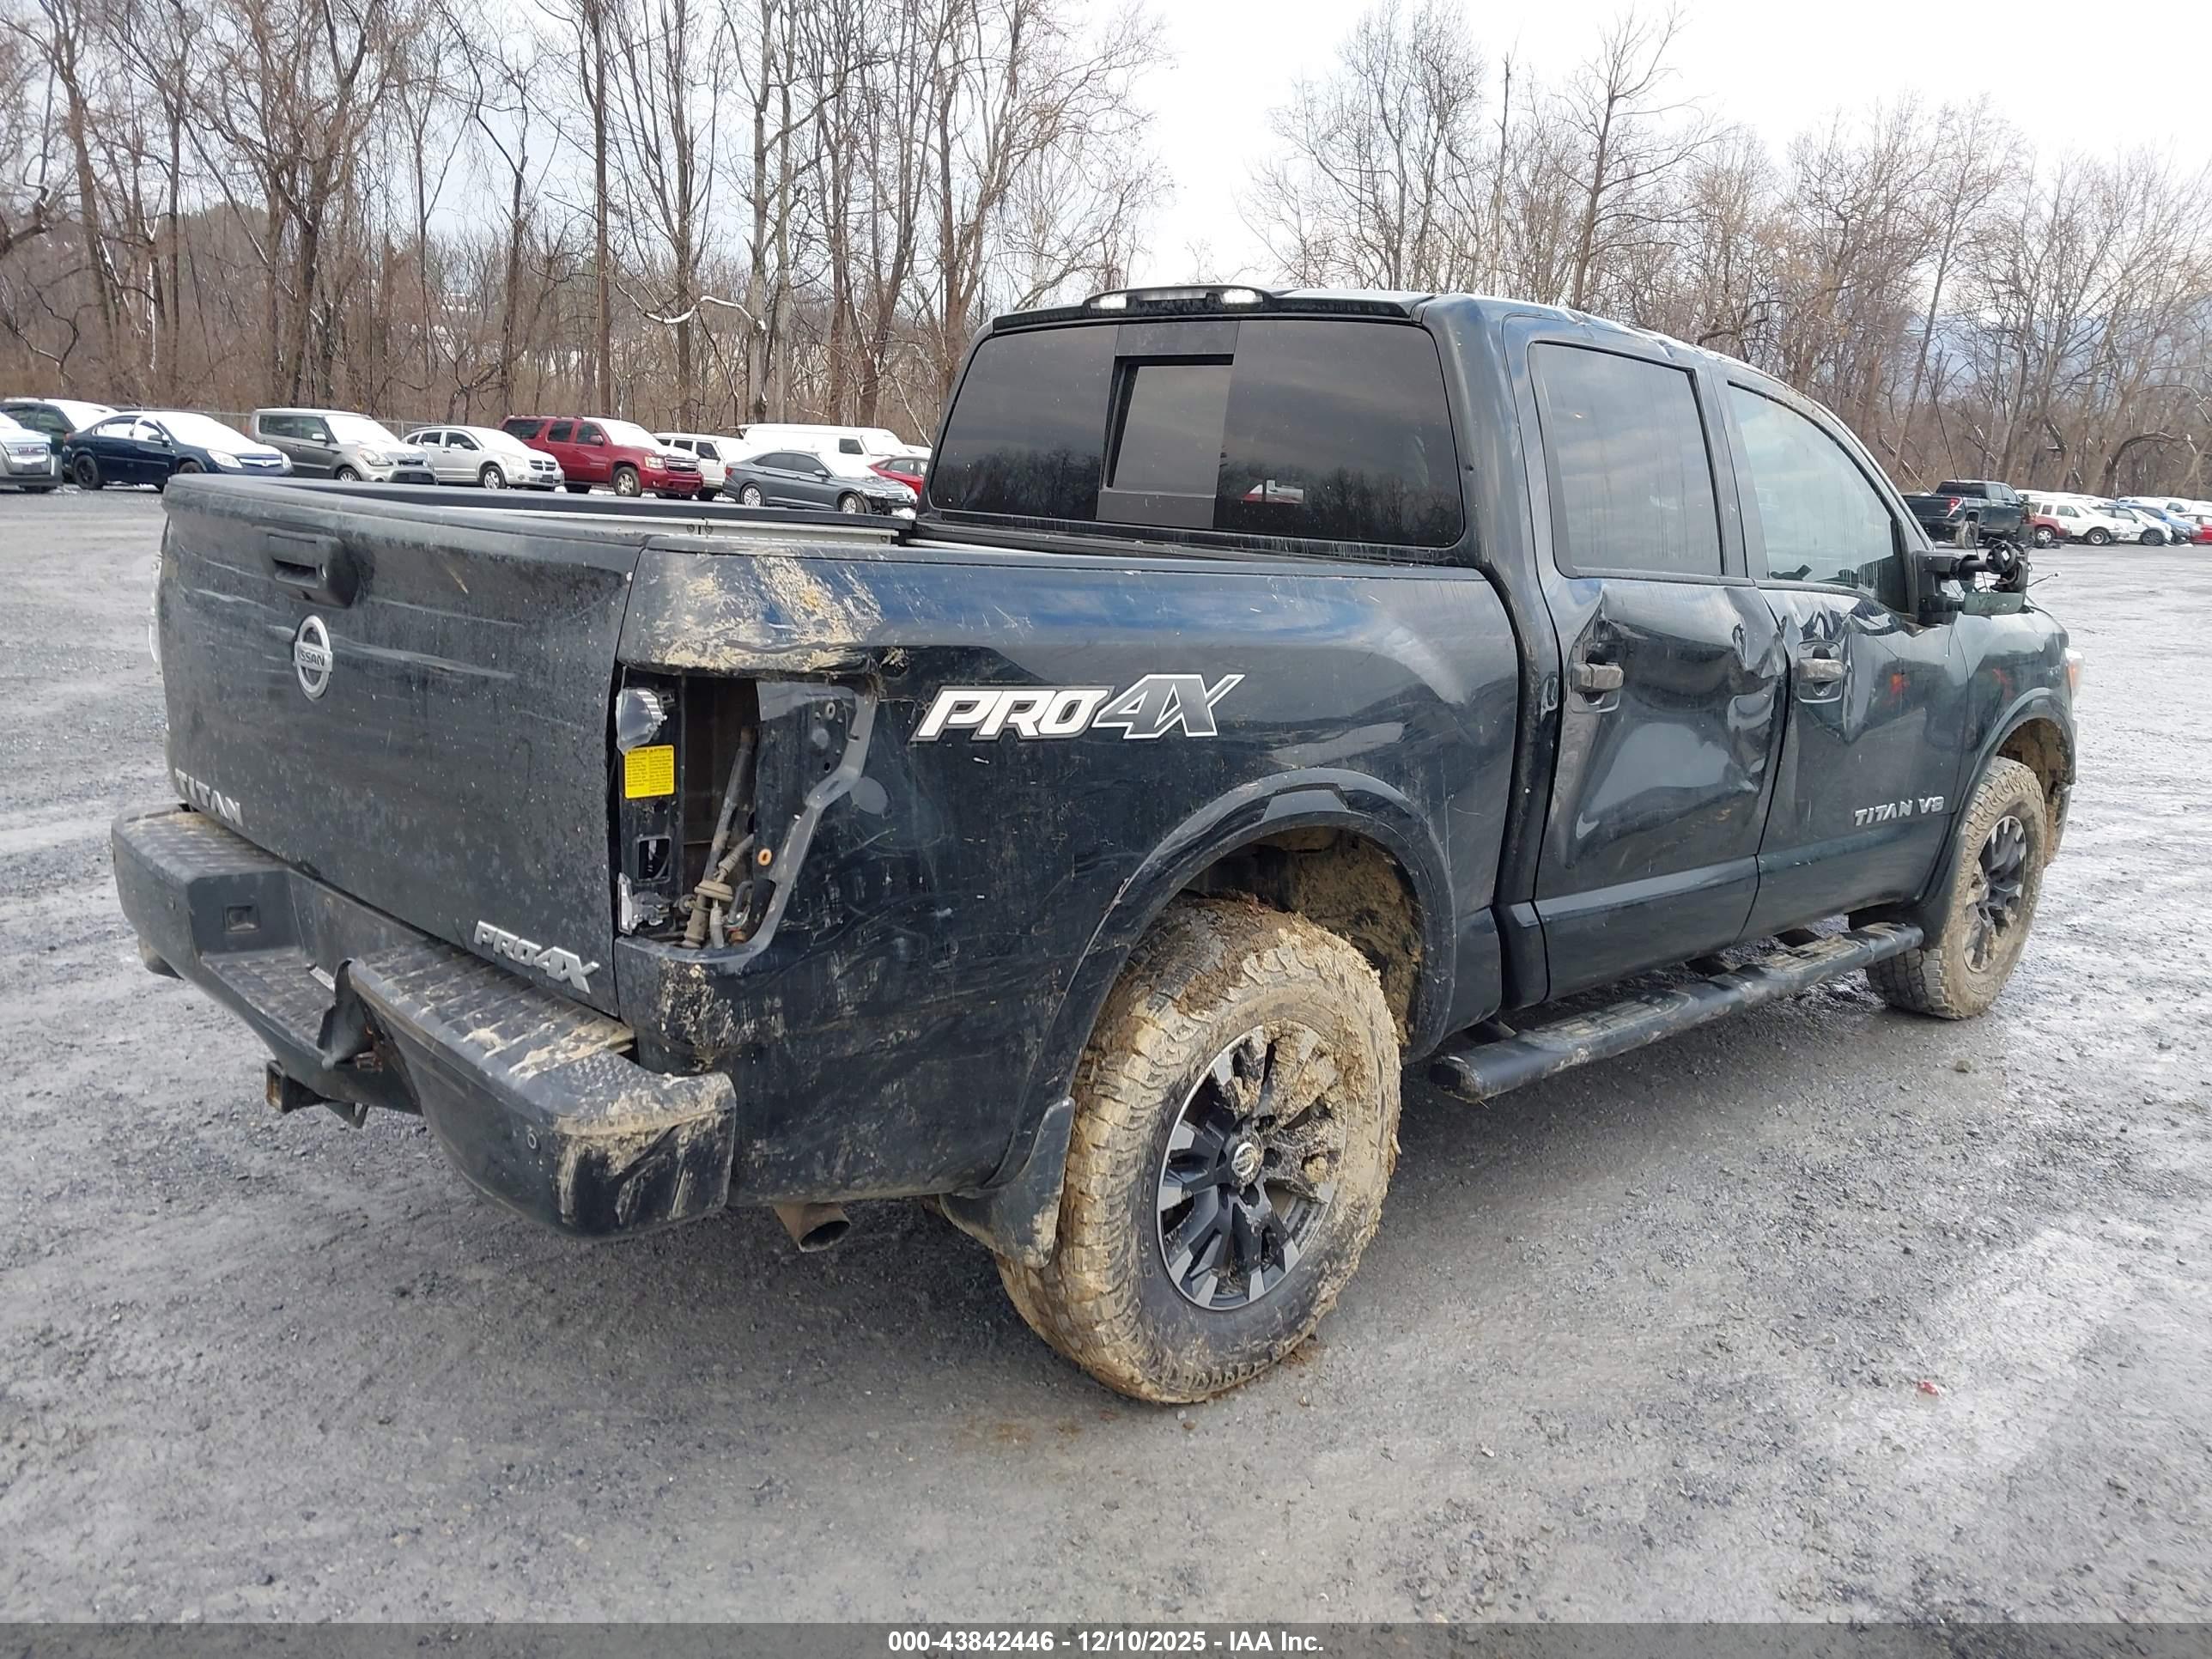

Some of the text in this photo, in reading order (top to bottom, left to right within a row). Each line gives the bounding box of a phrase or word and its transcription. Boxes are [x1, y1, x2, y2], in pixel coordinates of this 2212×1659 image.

[297, 650, 325, 667] SSAN
[174, 767, 243, 827] TITAN
[1855, 796, 1945, 826] TITAN V8
